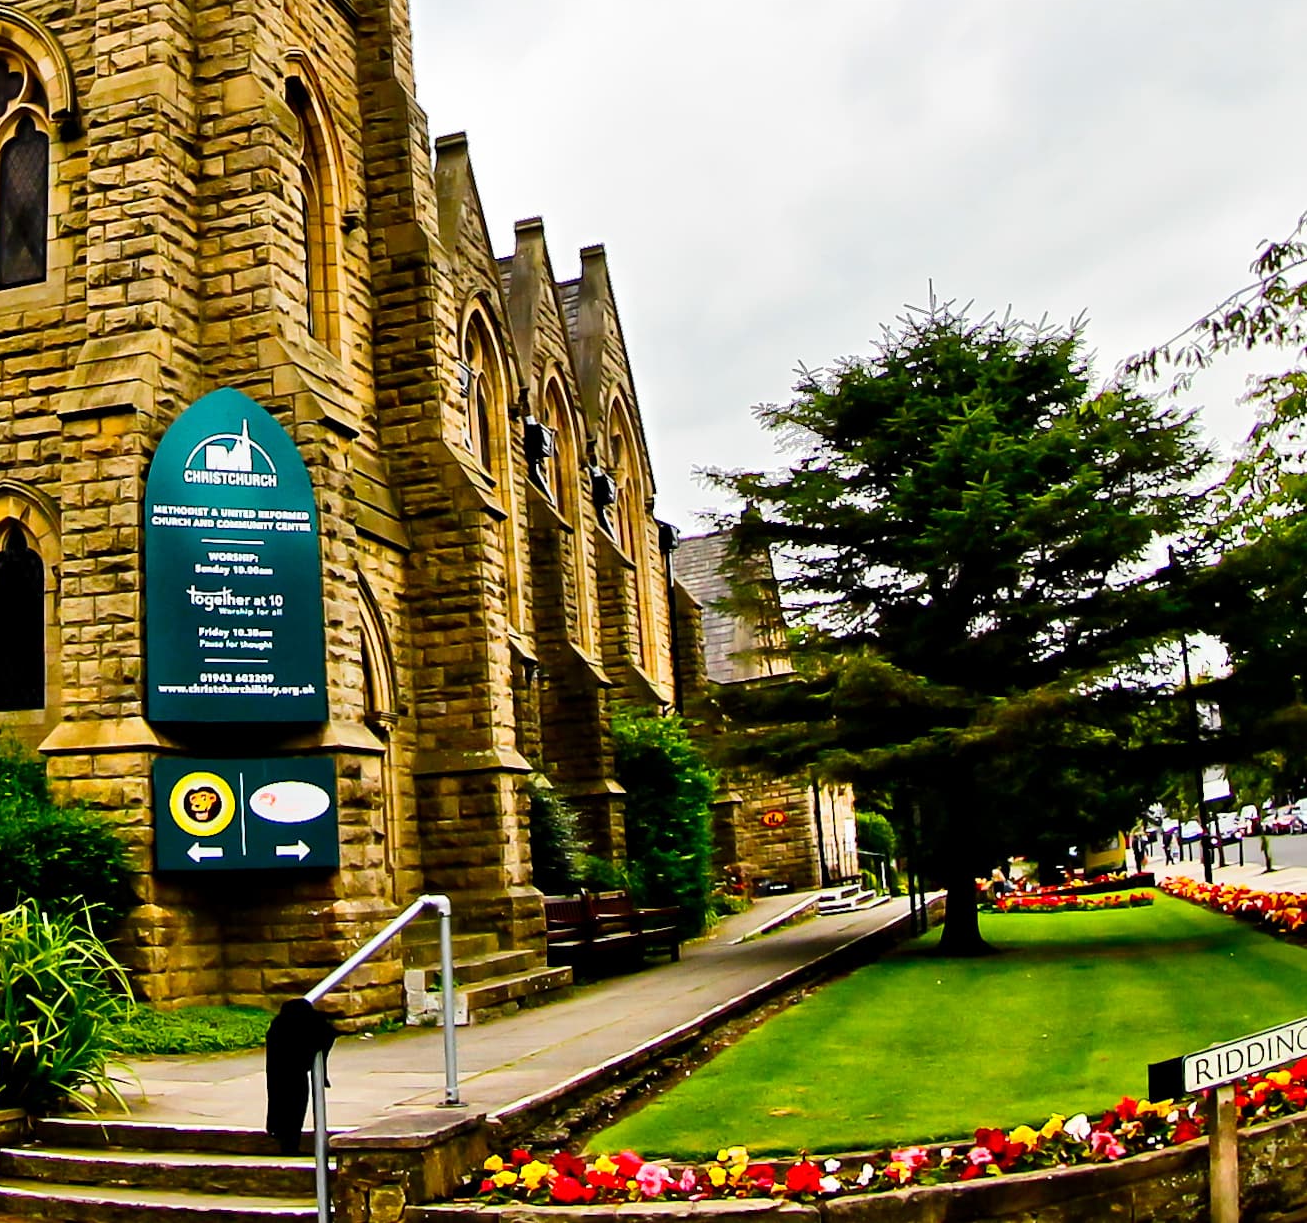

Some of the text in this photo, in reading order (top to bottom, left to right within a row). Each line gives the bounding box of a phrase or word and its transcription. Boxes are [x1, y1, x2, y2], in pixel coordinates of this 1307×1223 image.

[183, 470, 278, 487] CHRISTCHURCH
[153, 505, 310, 521] METHODIST & UNITED REFORMED
[151, 516, 191, 527] CHURCH
[193, 518, 215, 528] AND
[216, 520, 274, 531] COMMUNITY
[194, 564, 231, 576] Sunday
[186, 584, 284, 612] together at 10
[218, 607, 283, 617] Worship for all
[198, 627, 230, 639] Friday
[199, 639, 273, 651] Pause for thought
